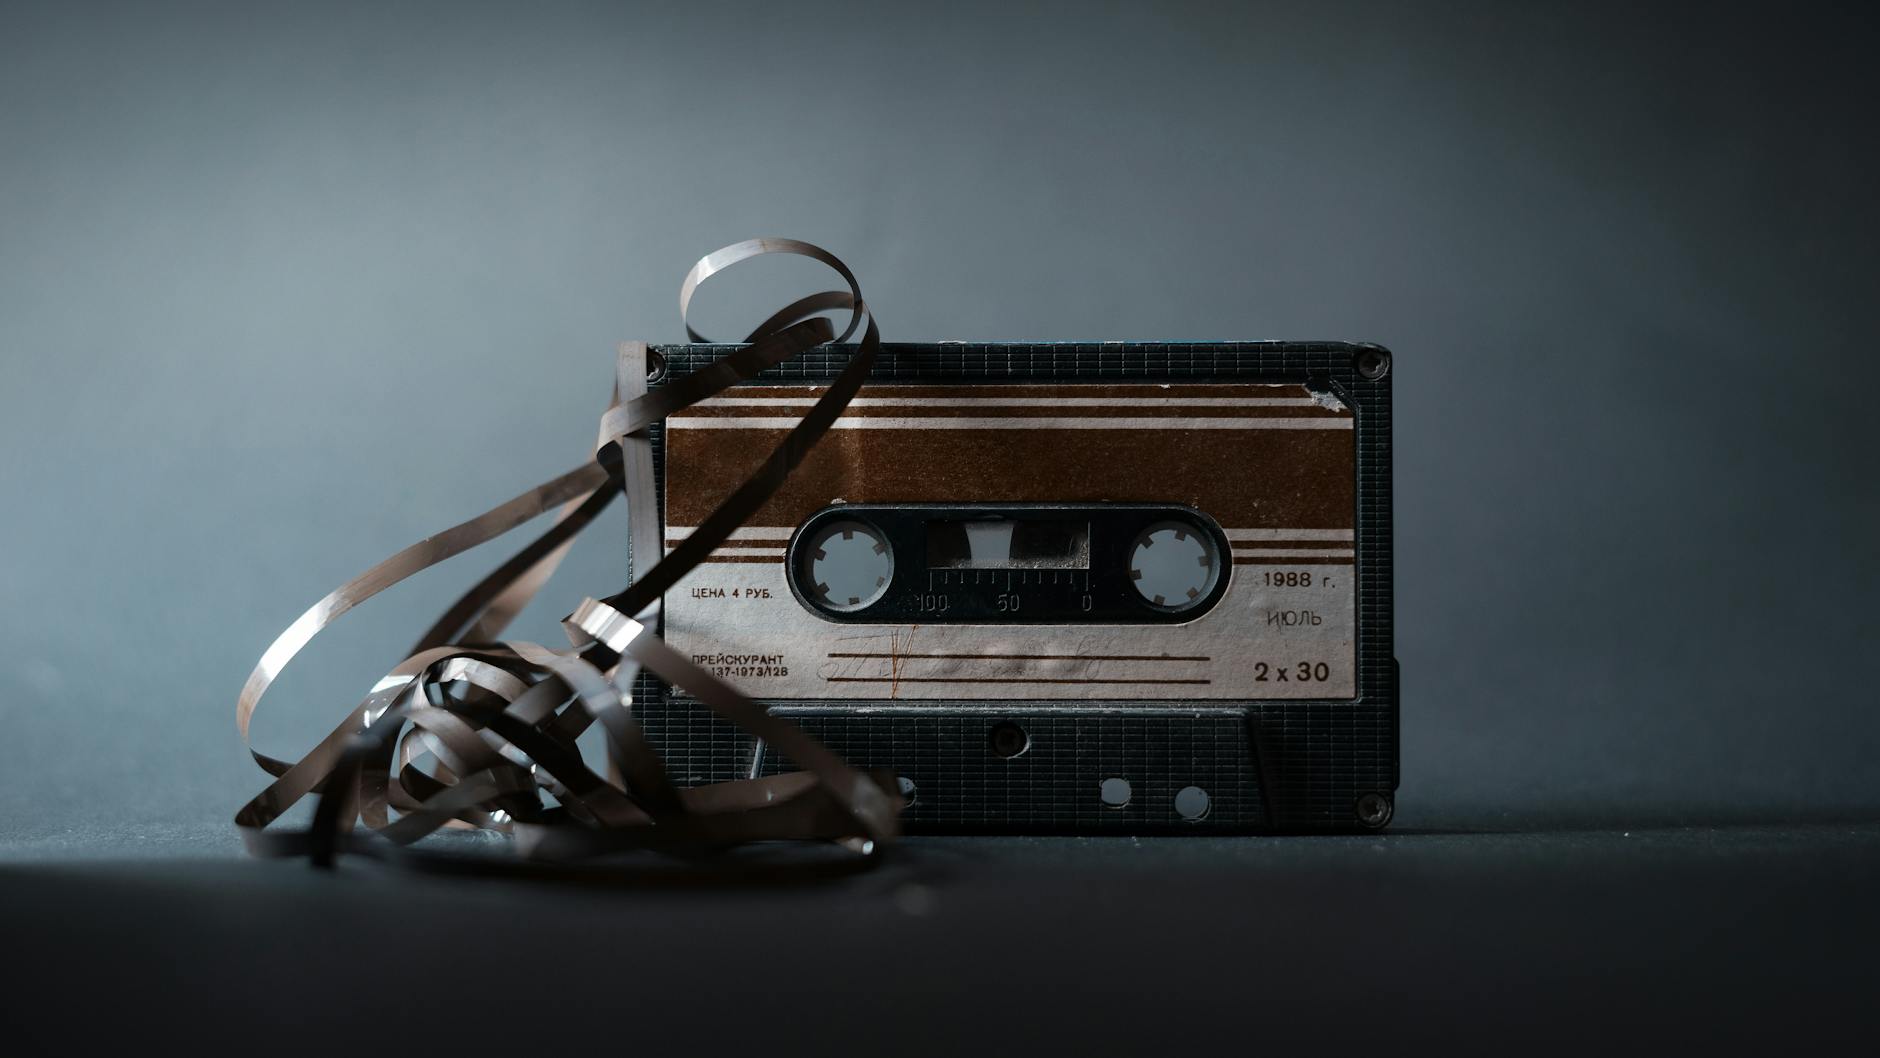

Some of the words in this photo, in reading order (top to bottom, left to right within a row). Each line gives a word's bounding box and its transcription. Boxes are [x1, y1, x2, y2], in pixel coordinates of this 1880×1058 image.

[1264, 571, 1312, 587] 1988
[1322, 576, 1336, 588] г.
[692, 587, 726, 600] ЦЕНА
[732, 588, 740, 599] 4
[745, 588, 773, 599] РУБ.
[917, 594, 948, 612] 100
[997, 594, 1020, 612] 50
[1082, 594, 1092, 612] 0
[1267, 610, 1322, 626] ИЮЛЬ
[691, 652, 784, 665] ПРЕЙСКУРАНТ
[1254, 661, 1269, 682] 2
[1296, 661, 1330, 682] 30
